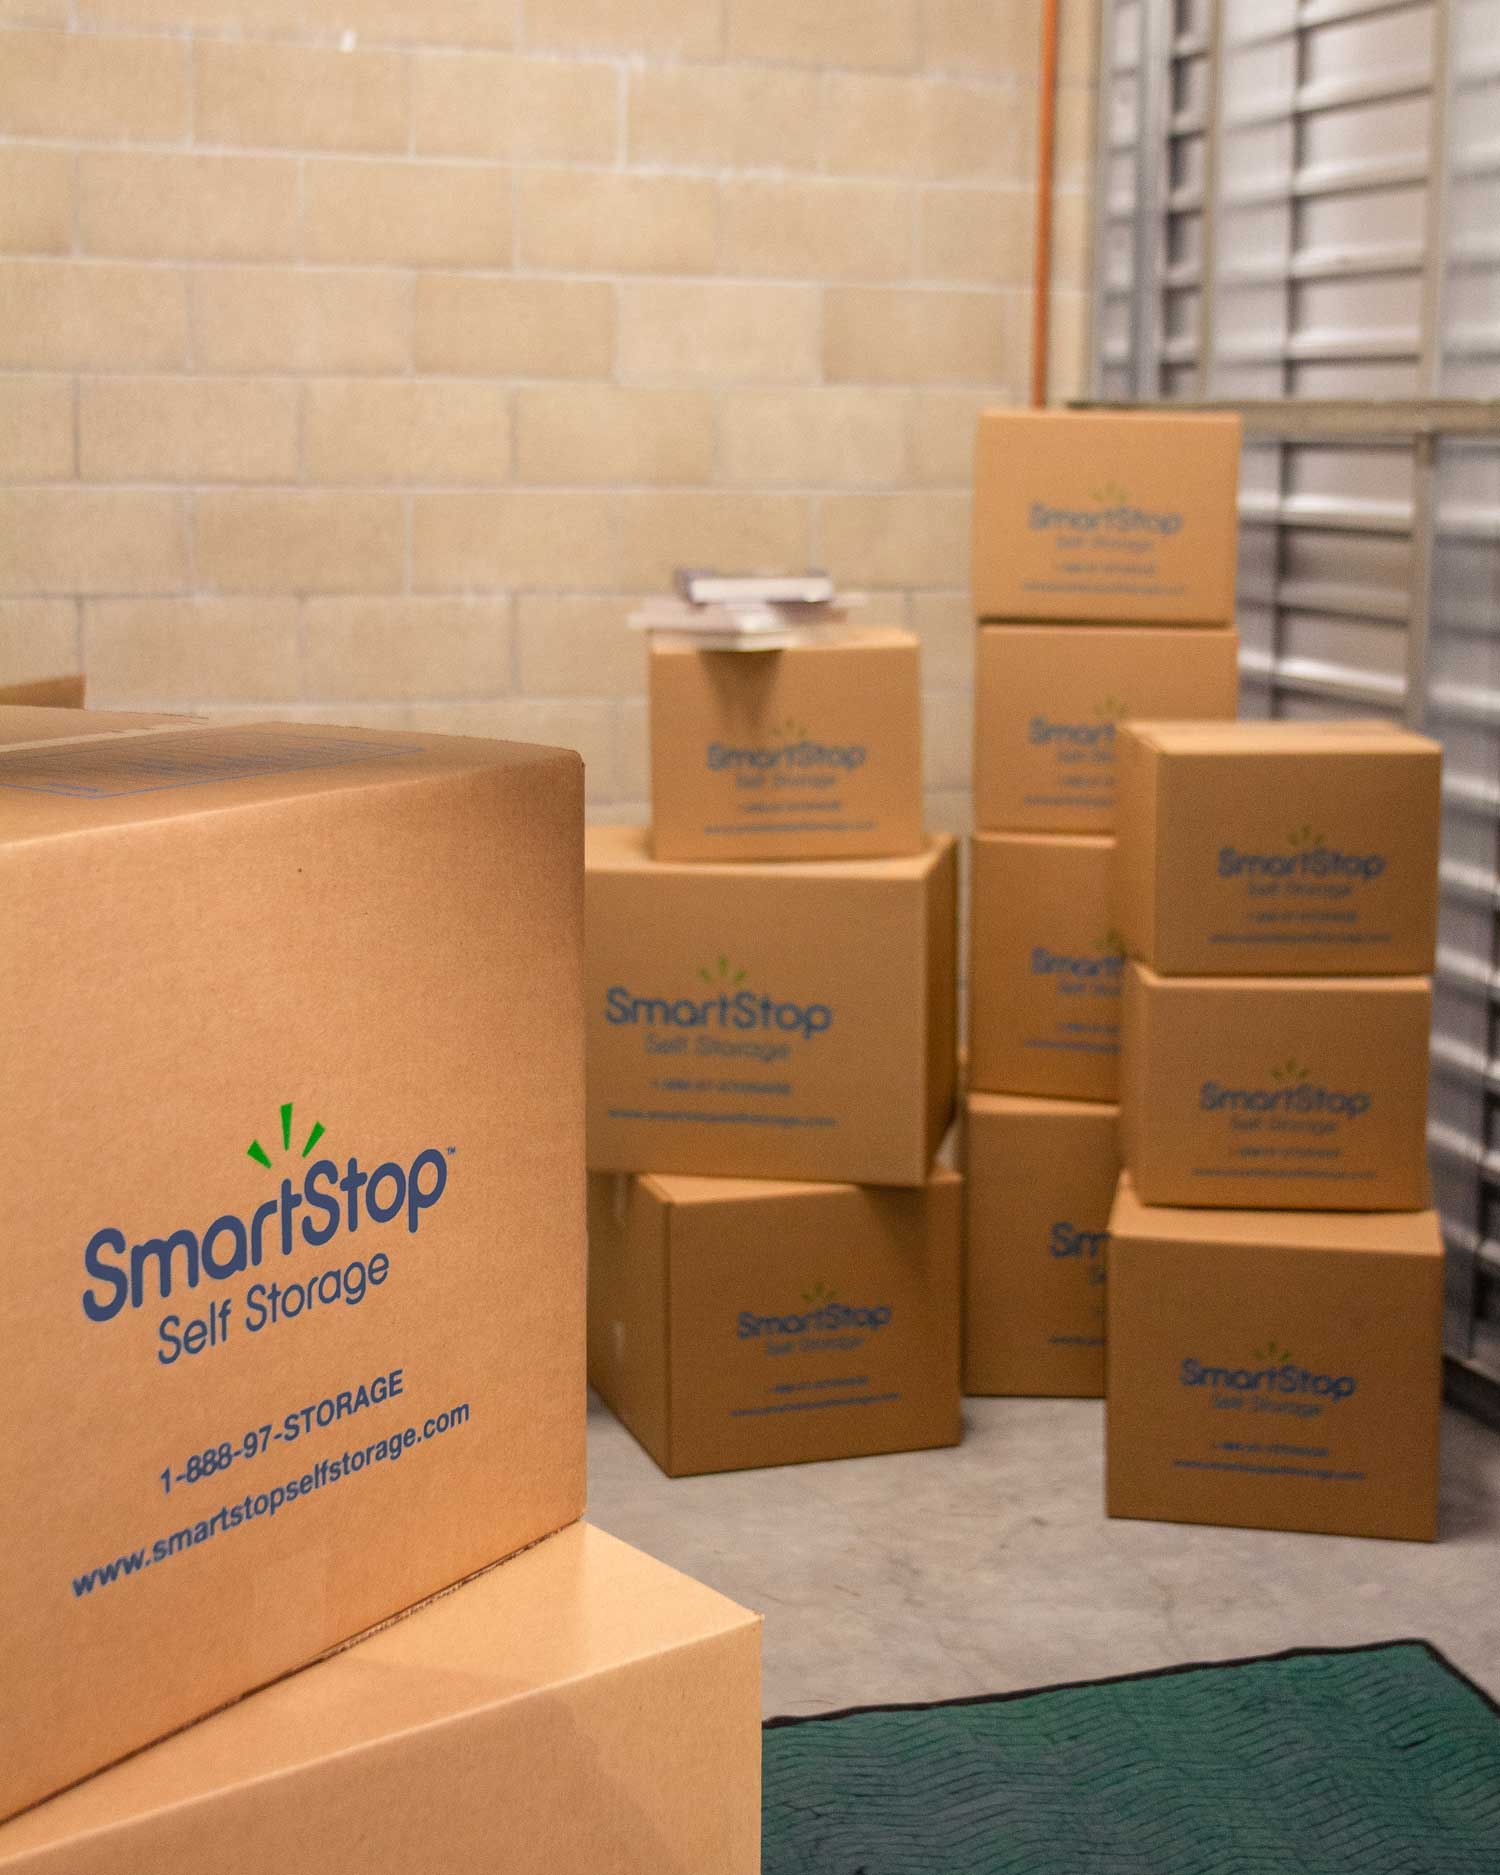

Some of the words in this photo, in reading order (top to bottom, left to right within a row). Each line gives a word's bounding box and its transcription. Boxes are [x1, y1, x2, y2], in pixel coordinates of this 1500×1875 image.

[1029, 715, 1117, 746] Smart
[605, 986, 833, 1040] SmartStop
[1201, 1081, 1372, 1119] SmartStop
[83, 1148, 448, 1323] SmartStop
[158, 1299, 233, 1365] Self
[245, 1252, 390, 1332] Storage
[737, 1302, 892, 1340] SmartStop
[1181, 1357, 1358, 1404] SmartStop
[160, 1369, 404, 1494] 1-888-97-STORAGE
[72, 1402, 471, 1597] www.smartstopselfstorage.com
